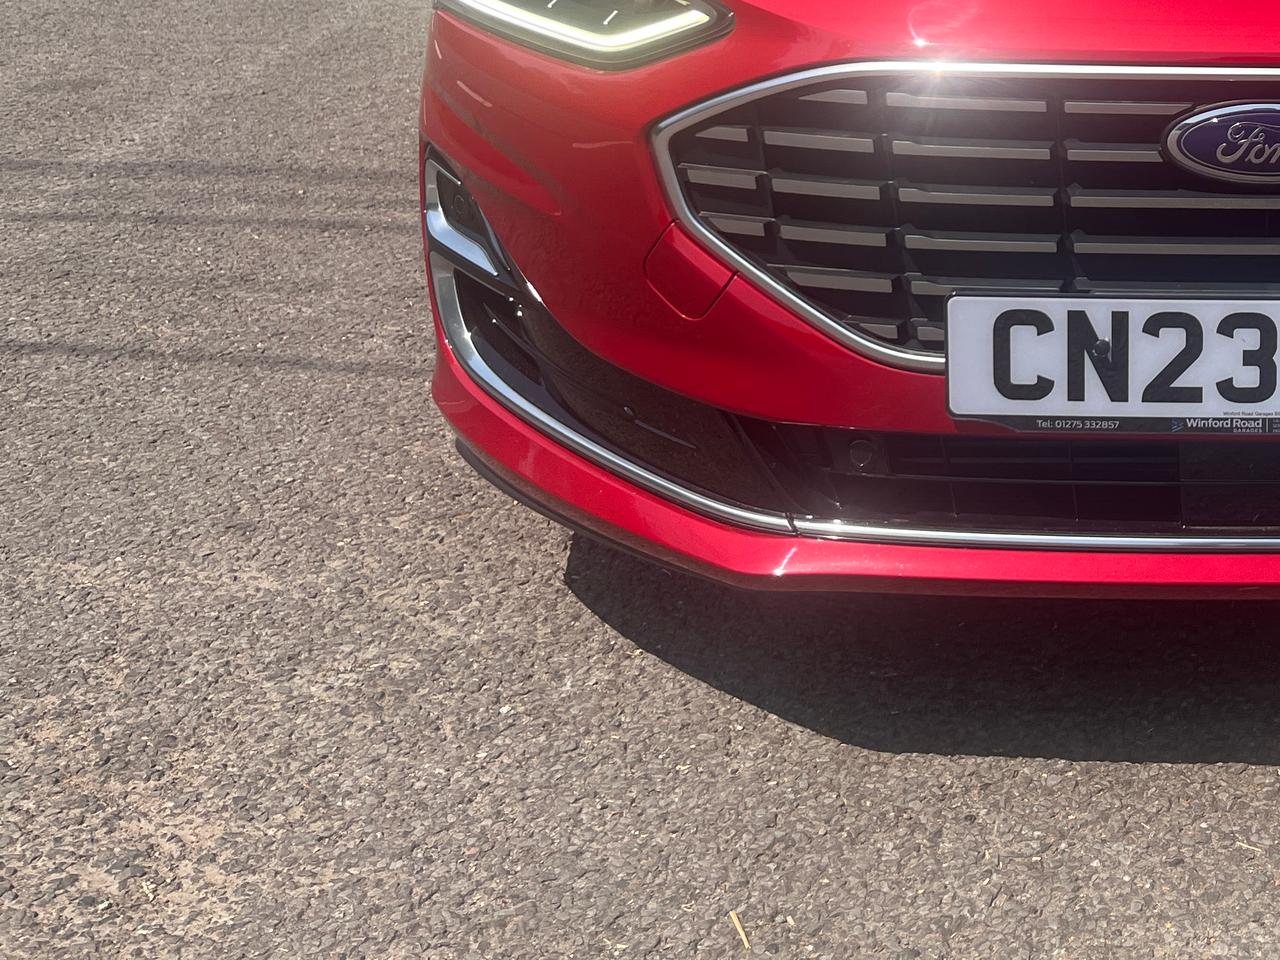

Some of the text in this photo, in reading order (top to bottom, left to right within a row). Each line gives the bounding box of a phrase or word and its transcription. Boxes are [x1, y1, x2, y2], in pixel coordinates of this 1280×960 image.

[993, 309, 1278, 403] CN23
[1036, 420, 1119, 429] Tel: 01275 332857
[1186, 418, 1262, 428] Winford Road
